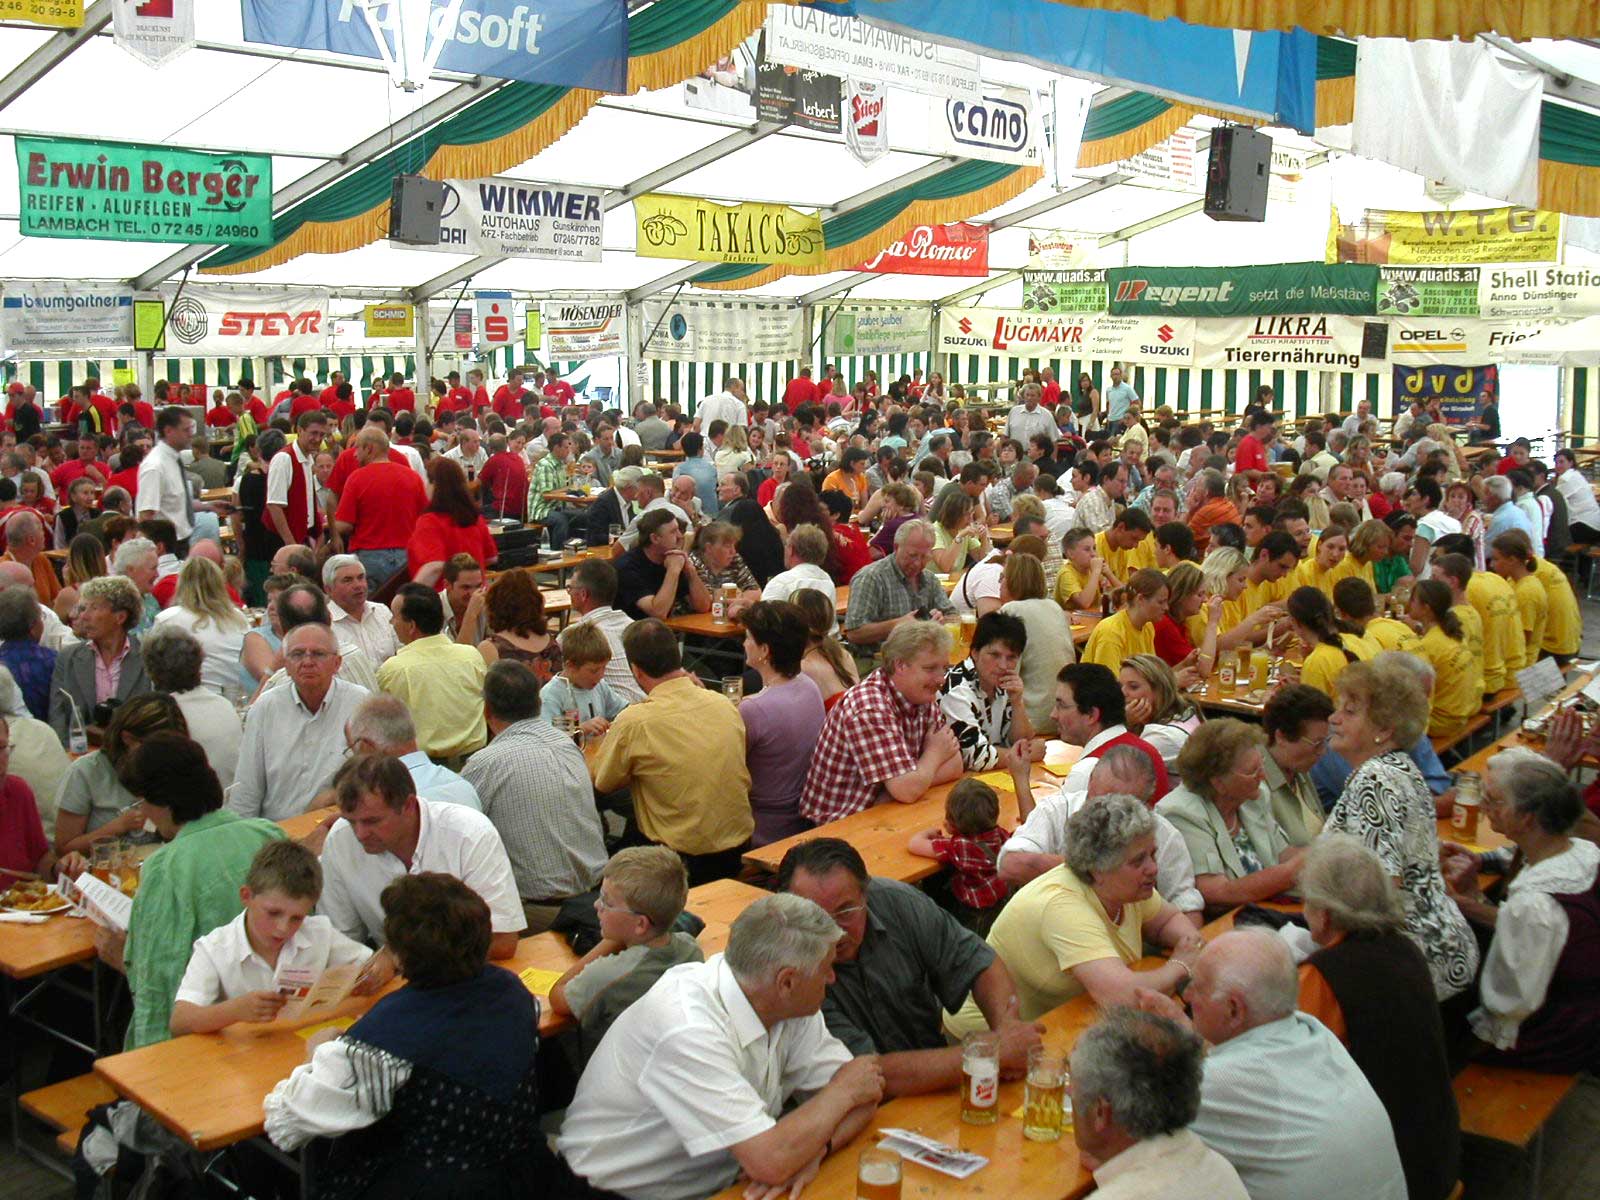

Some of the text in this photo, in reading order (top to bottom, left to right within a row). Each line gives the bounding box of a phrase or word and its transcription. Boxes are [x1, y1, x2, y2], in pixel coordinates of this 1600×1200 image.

[851, 93, 884, 124] Stiegl
[952, 100, 1022, 143] camo
[27, 152, 260, 205] Erwin Berger
[27, 193, 192, 218] REIFEN ALUFELGEN
[479, 183, 601, 221] WIMMER
[28, 216, 110, 233] LAMBACH
[115, 219, 147, 234] TEL.
[164, 222, 184, 235] 72
[185, 223, 204, 236] 45
[481, 214, 541, 231] AUTOHAUS
[552, 220, 601, 233] Gunskirchen
[1421, 207, 1548, 237] W.T.G.
[480, 229, 539, 242] KFZ-Fachbetrieb
[552, 232, 600, 246] 07246/7782
[696, 209, 787, 256] TAKACS
[910, 226, 977, 261] Romeo
[1023, 270, 1106, 284] www.quads.at
[1379, 268, 1479, 283] www.quads.at
[1490, 271, 1538, 290] Shell
[23, 293, 118, 312] baumgartner
[1114, 280, 1236, 307] Regent
[1249, 285, 1371, 302] setzt die Maßstäbe
[1490, 292, 1517, 302] Anna
[373, 310, 407, 319] SCHMID
[560, 304, 623, 321] MÖSENEDER
[1006, 316, 1084, 325] AUTOHAUS
[218, 310, 322, 336] STEYR
[1254, 316, 1327, 336] LIKRA
[943, 336, 988, 347] SUZUKI
[992, 316, 1083, 350] LUGMAYR
[1399, 329, 1448, 341] OPEL
[1054, 345, 1083, 353] WELS
[1140, 344, 1190, 356] SUZUKI
[1224, 347, 1360, 368] Tierernährung
